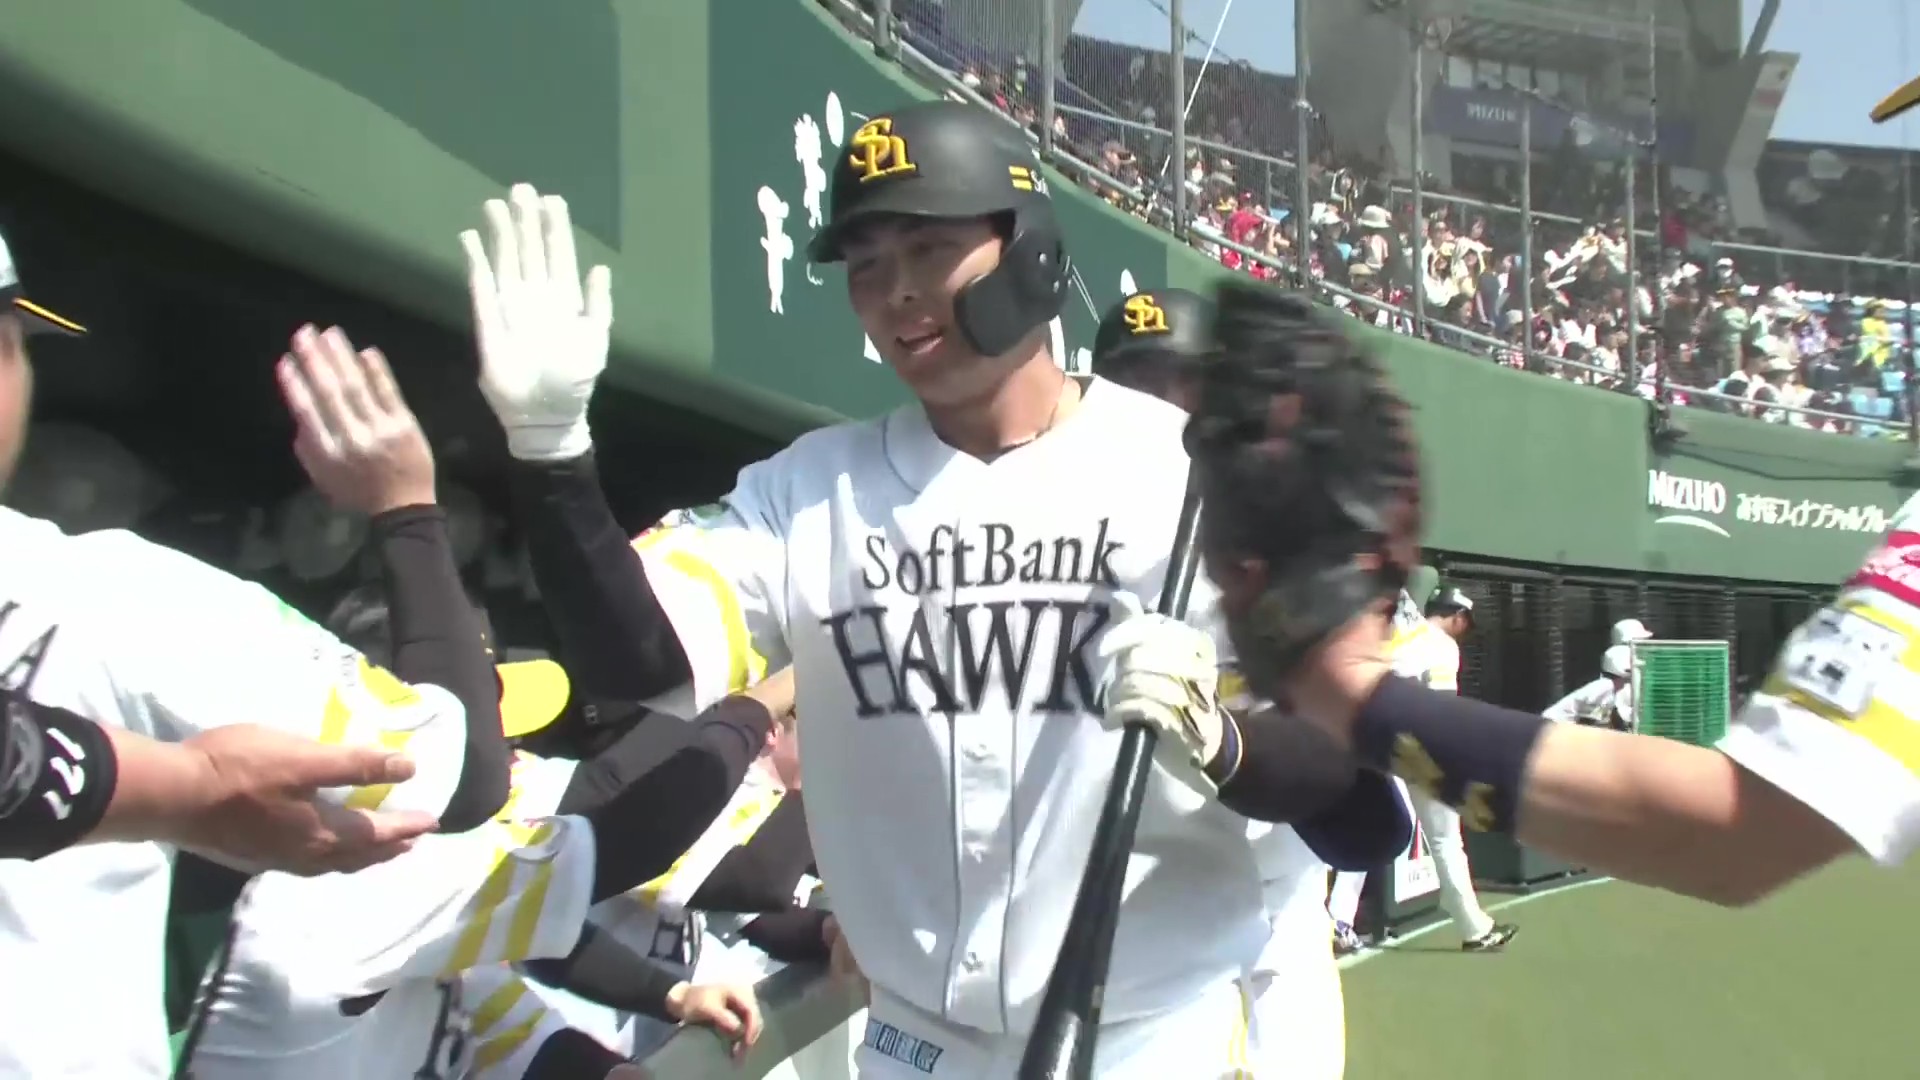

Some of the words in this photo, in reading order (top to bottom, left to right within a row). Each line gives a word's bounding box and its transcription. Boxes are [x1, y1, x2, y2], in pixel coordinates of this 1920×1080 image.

[1648, 469, 1726, 514] MIZUHO
[862, 517, 1125, 596] SoftBank
[820, 599, 1110, 719] HAWK
